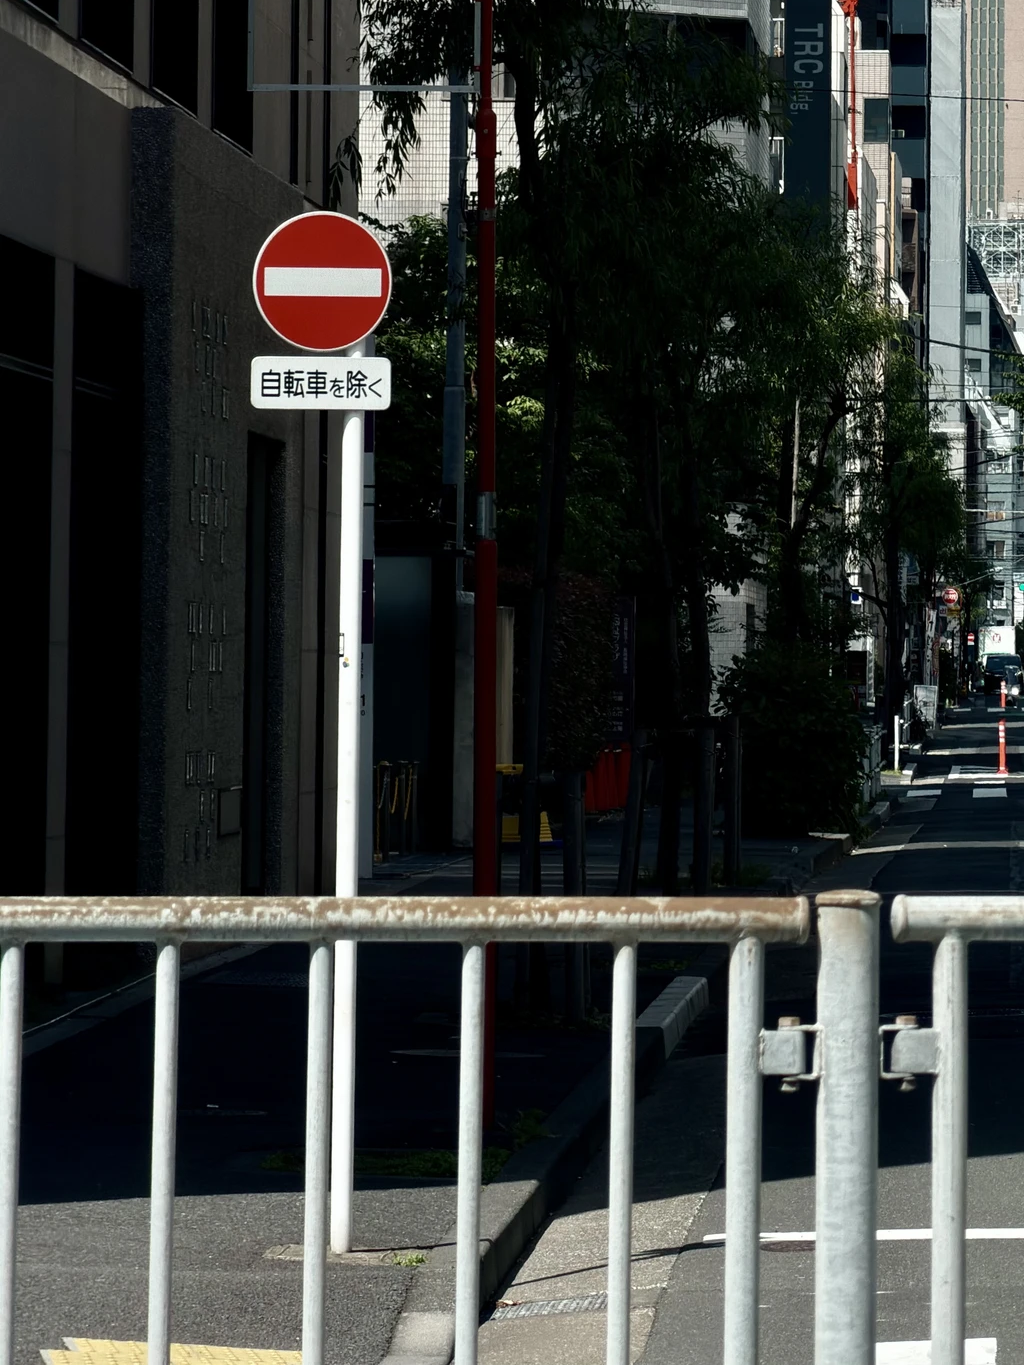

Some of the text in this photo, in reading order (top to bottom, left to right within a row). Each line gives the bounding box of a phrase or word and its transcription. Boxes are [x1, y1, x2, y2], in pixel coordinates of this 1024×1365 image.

[793, 22, 824, 74] TRC
[260, 368, 383, 399] 自転車を除く
